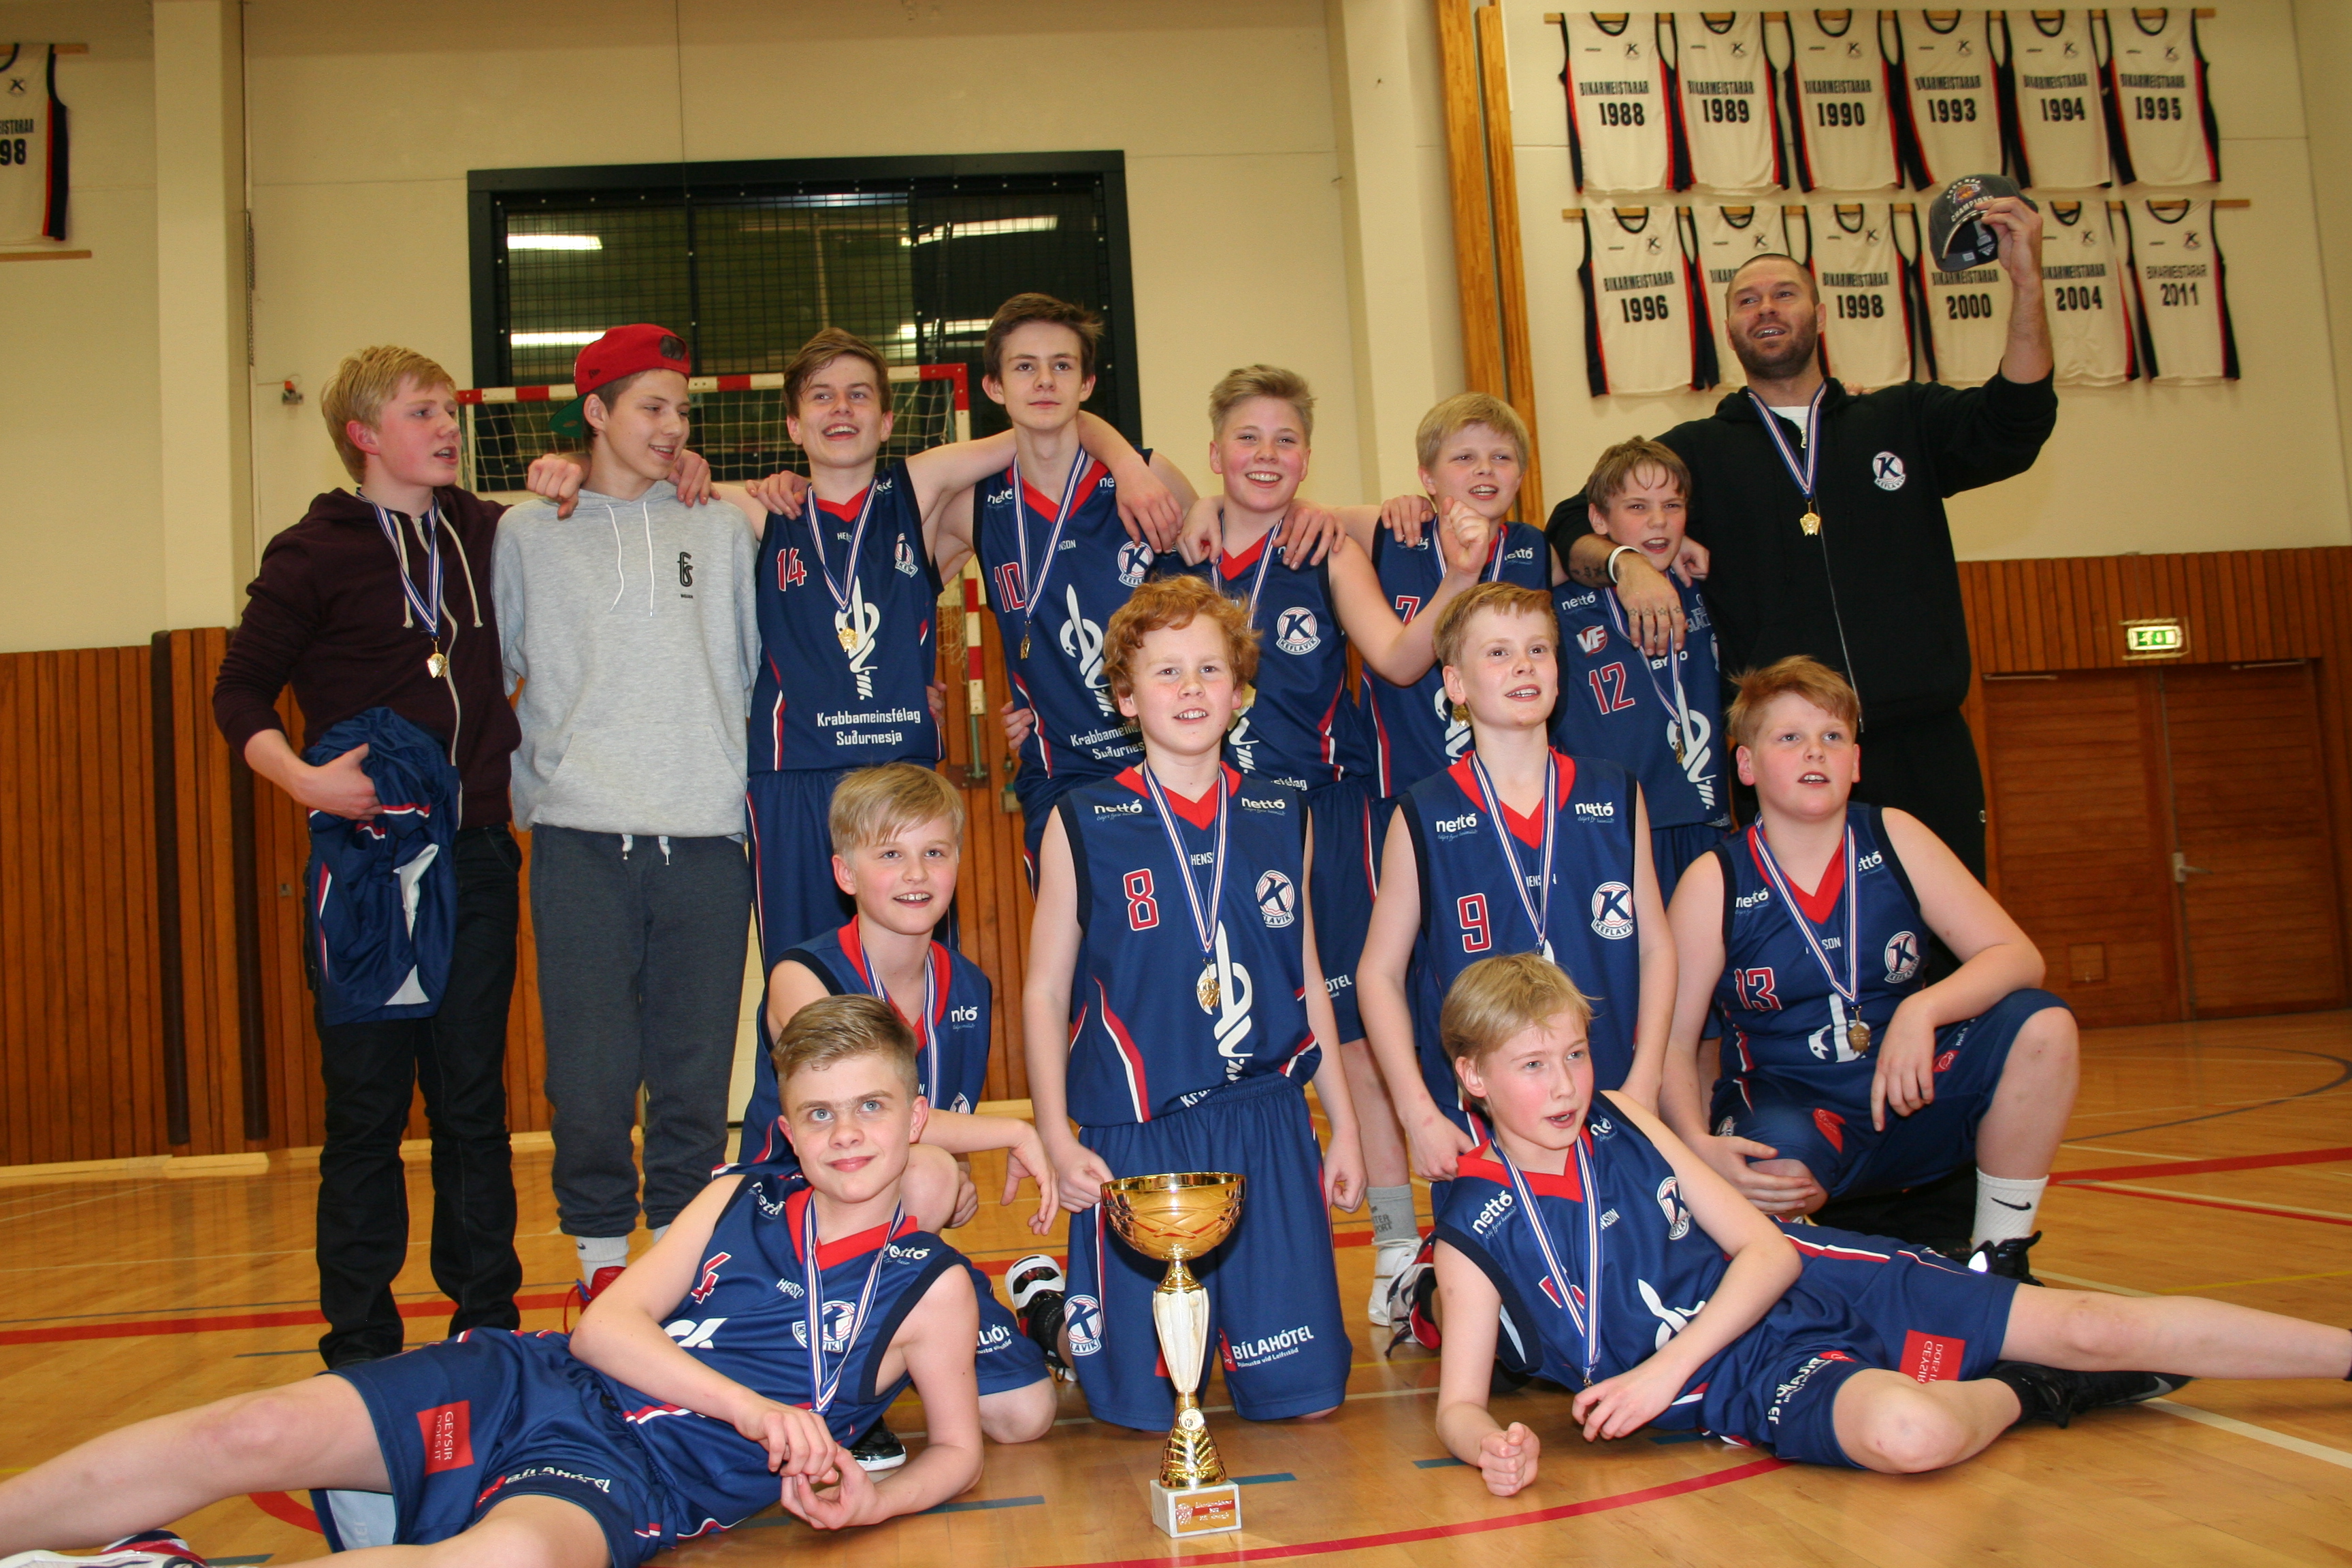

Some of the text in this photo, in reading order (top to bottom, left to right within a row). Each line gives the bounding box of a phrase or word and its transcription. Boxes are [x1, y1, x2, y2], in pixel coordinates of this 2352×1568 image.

[1599, 102, 1645, 126] 1988
[1702, 99, 1750, 122] 1989
[1817, 102, 1865, 127] 1990
[1927, 99, 1976, 122] 1993
[2041, 97, 2085, 121] 1994
[2135, 97, 2181, 120] 1995
[1837, 295, 1884, 318] 1998
[1946, 294, 1991, 319] 2000
[2055, 287, 2102, 311] 2004
[2161, 282, 2198, 306] 2011
[1621, 295, 1669, 323] 1996
[777, 547, 807, 591] 14
[994, 562, 1025, 612] 10
[1395, 595, 1420, 625] 7
[1651, 651, 1688, 670] BYO
[1589, 662, 1635, 715] 12
[817, 707, 921, 726] Krabbameinsfélag
[836, 730, 902, 745] Suðurnesja
[1123, 868, 1159, 931] 8
[1456, 892, 1492, 953] 9
[1734, 966, 1782, 1012] 13
[1232, 1325, 1314, 1360] BÍLAHÓTEL
[434, 1415, 443, 1461] DOES IT
[444, 1411, 454, 1461] GEYSIR
